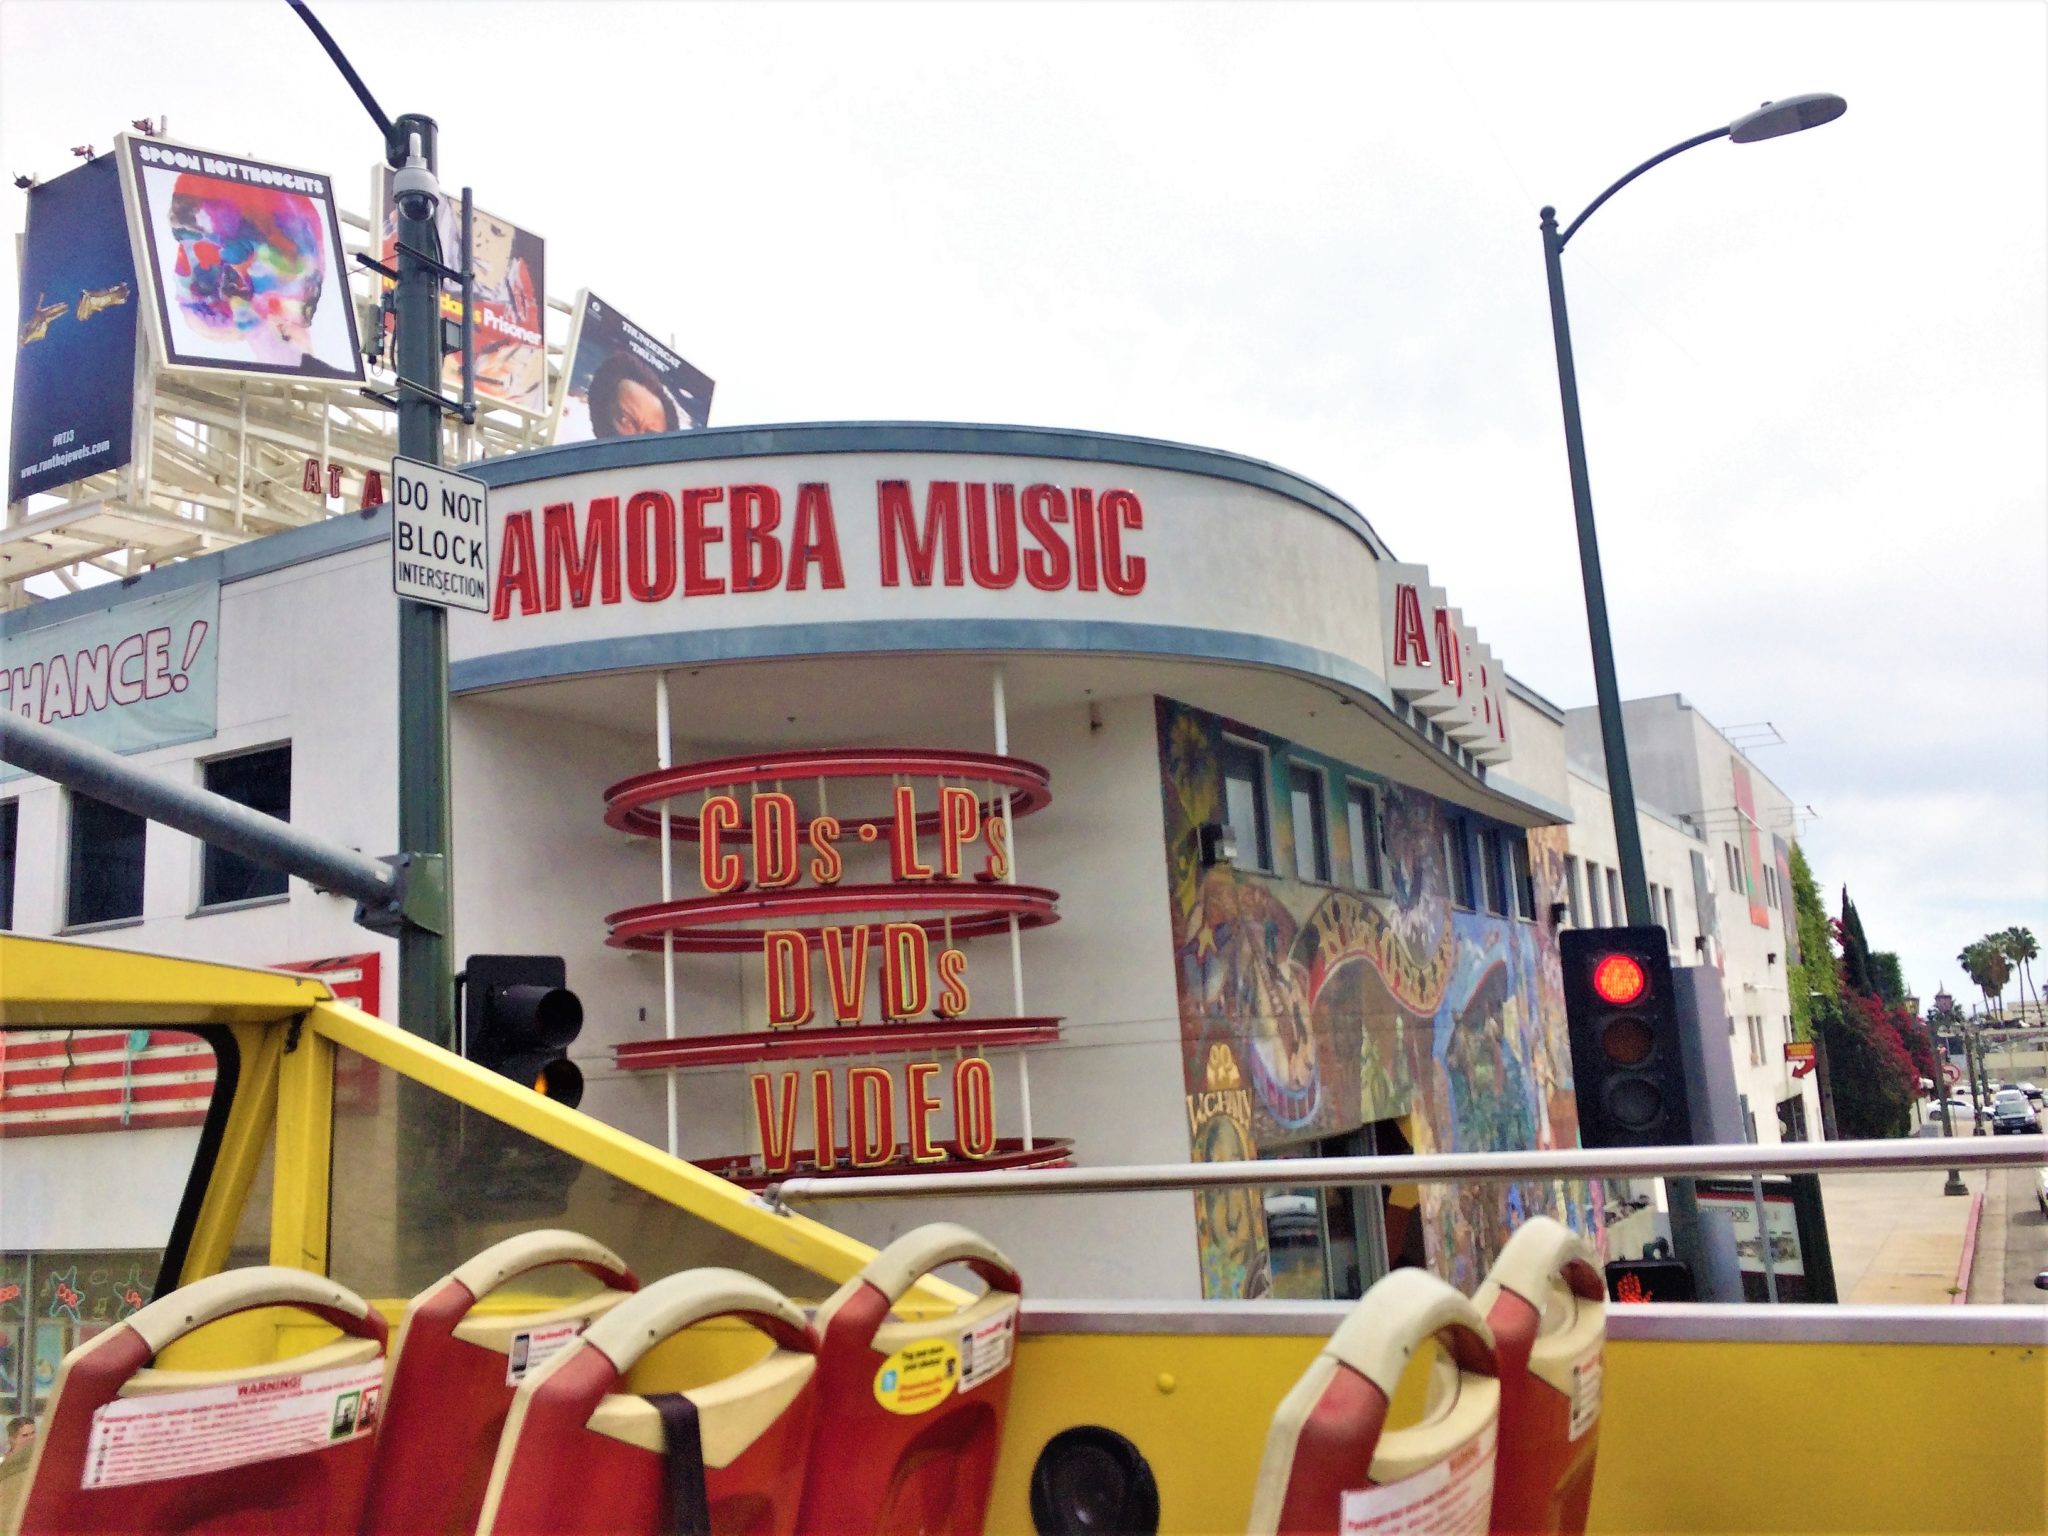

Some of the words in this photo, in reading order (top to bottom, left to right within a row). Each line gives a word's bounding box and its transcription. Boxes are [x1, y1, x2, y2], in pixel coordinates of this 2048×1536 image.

[139, 145, 200, 171] SPOON
[203, 157, 238, 178] HOT
[239, 164, 324, 194] THOUGHTS
[483, 307, 542, 345] Prisoner
[21, 440, 110, 479] www.runthejewels.com
[398, 475, 429, 511] DO
[441, 488, 482, 526] NOT
[398, 521, 484, 570] BLOCK
[492, 481, 846, 621] AMOEBA
[876, 479, 1148, 595] MUSIC
[399, 561, 485, 600] INTERSECTION
[699, 791, 843, 893] CDs
[891, 786, 1010, 881] LPs
[763, 922, 970, 1028] DVDs
[751, 1057, 998, 1174] VIDEO
